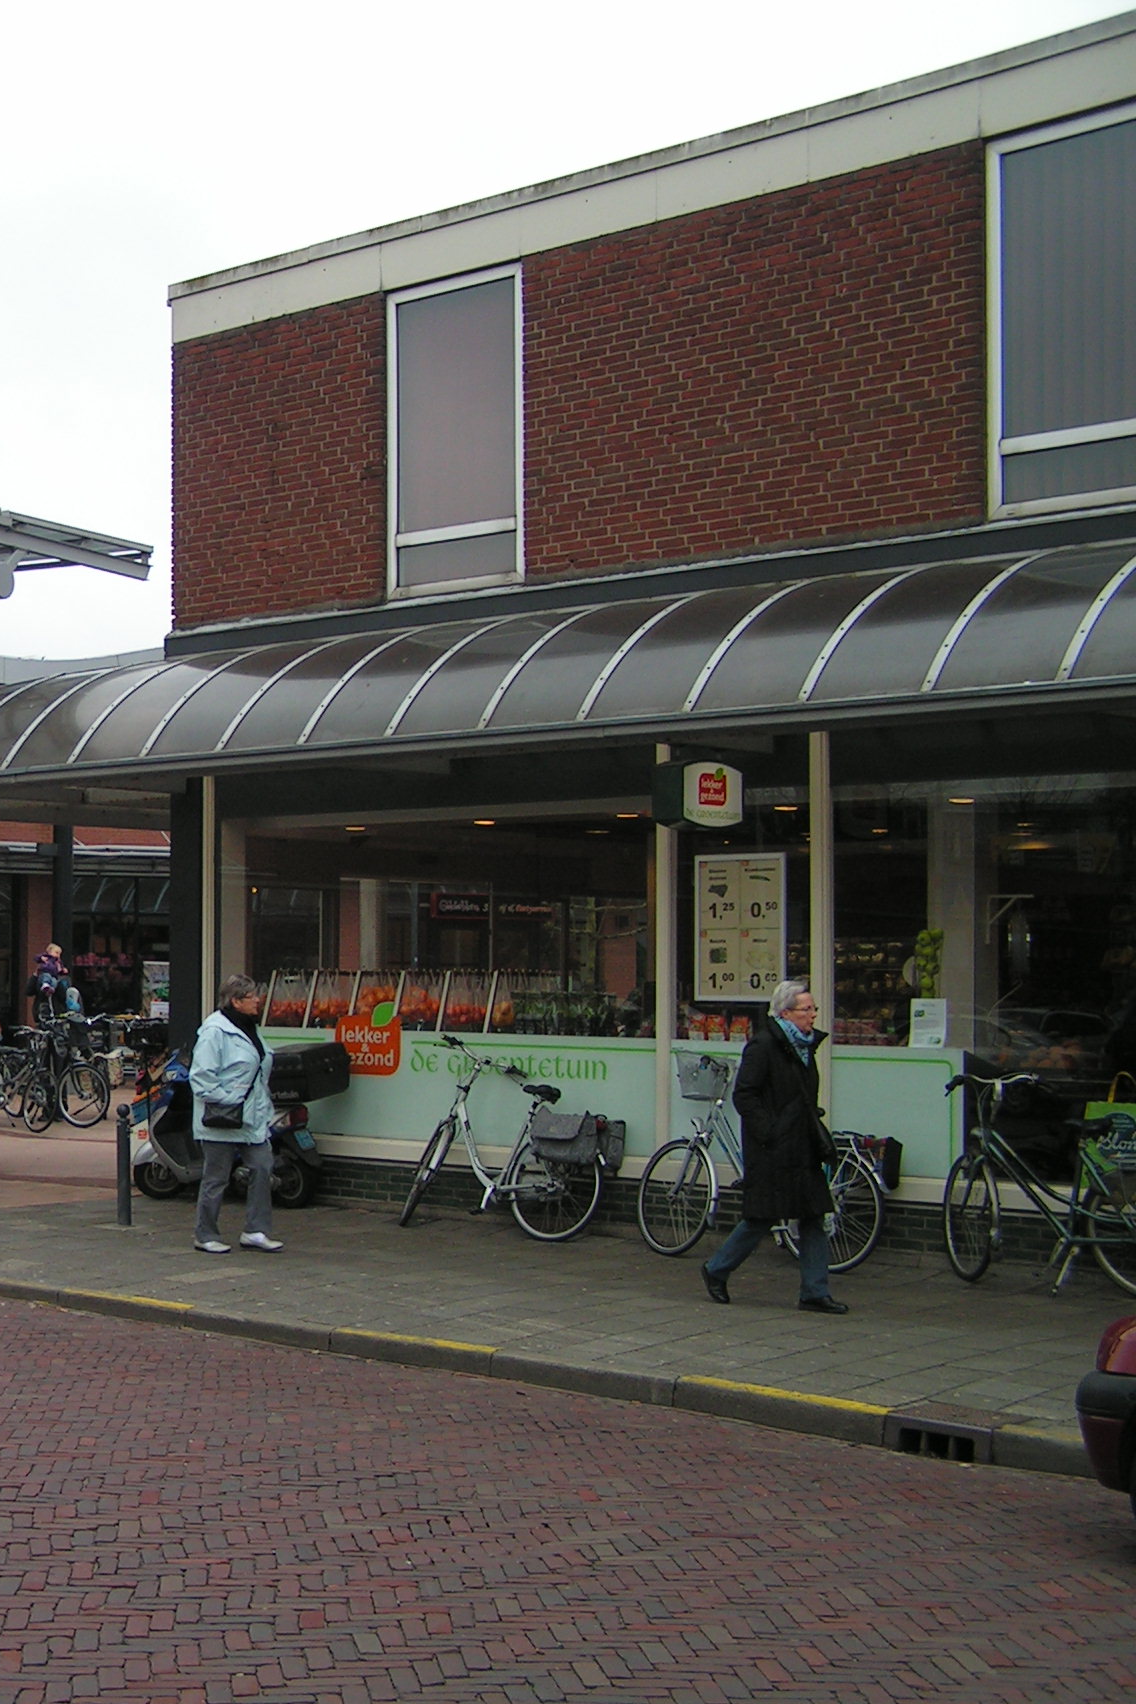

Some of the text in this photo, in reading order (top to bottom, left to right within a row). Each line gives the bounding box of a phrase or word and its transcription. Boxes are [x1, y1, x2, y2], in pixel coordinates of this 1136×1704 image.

[708, 902, 735, 920] 1,25
[750, 901, 778, 919] 0,50
[708, 972, 735, 990] 1,00
[341, 1024, 391, 1043] lekker
[361, 1043, 370, 1053] &
[349, 1048, 394, 1067] ezond
